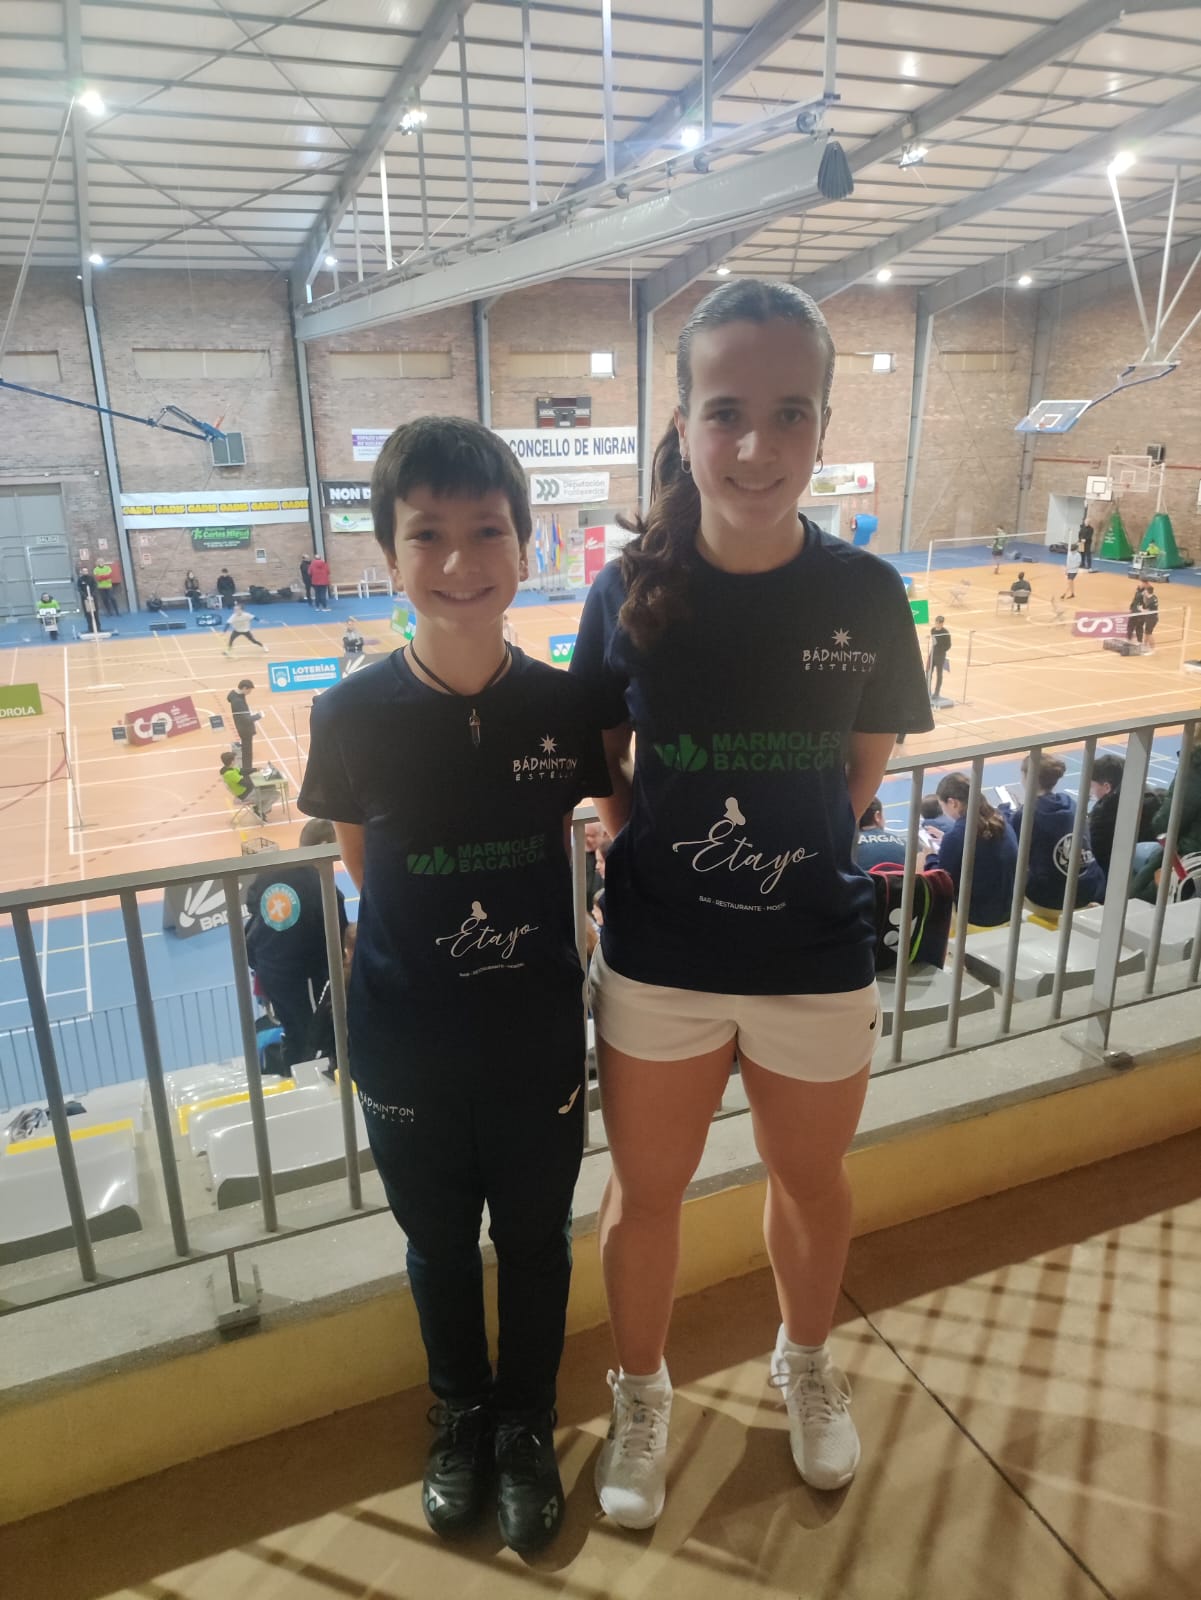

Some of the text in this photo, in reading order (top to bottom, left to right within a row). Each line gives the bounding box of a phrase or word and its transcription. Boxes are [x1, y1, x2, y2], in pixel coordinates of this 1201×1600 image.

[509, 436, 636, 457] CONCELLO DE NIGRAN
[329, 487, 361, 500] NON
[292, 663, 336, 675] LOTERÍAS
[711, 731, 841, 752] MARMOLES
[457, 834, 545, 858] MARMOLES
[672, 819, 819, 894] Etayo
[715, 899, 762, 912] RESTAURANTE
[436, 917, 539, 959] Etayo
